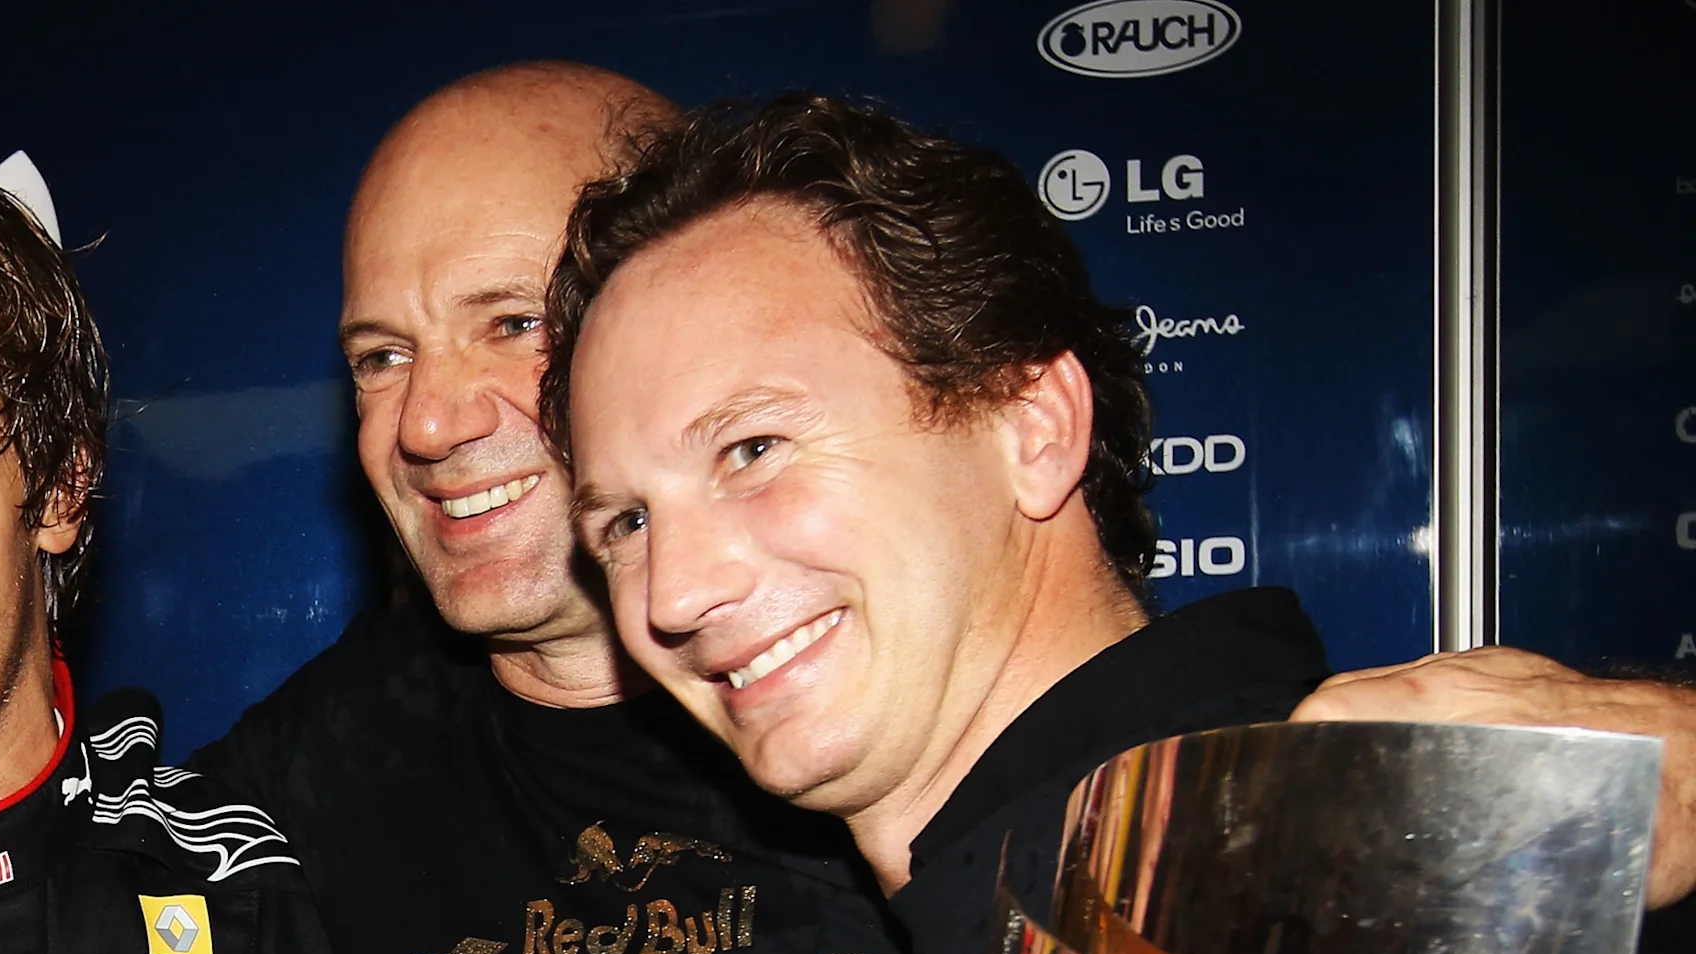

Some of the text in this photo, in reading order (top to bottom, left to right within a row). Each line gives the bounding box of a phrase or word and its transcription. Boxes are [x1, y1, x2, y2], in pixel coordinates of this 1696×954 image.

[1092, 14, 1216, 56] RAUCH
[1126, 154, 1205, 203] LG
[1186, 207, 1246, 231] Good
[1136, 305, 1246, 357] Jeans
[1144, 361, 1184, 374] DON
[1146, 536, 1246, 579] SIO
